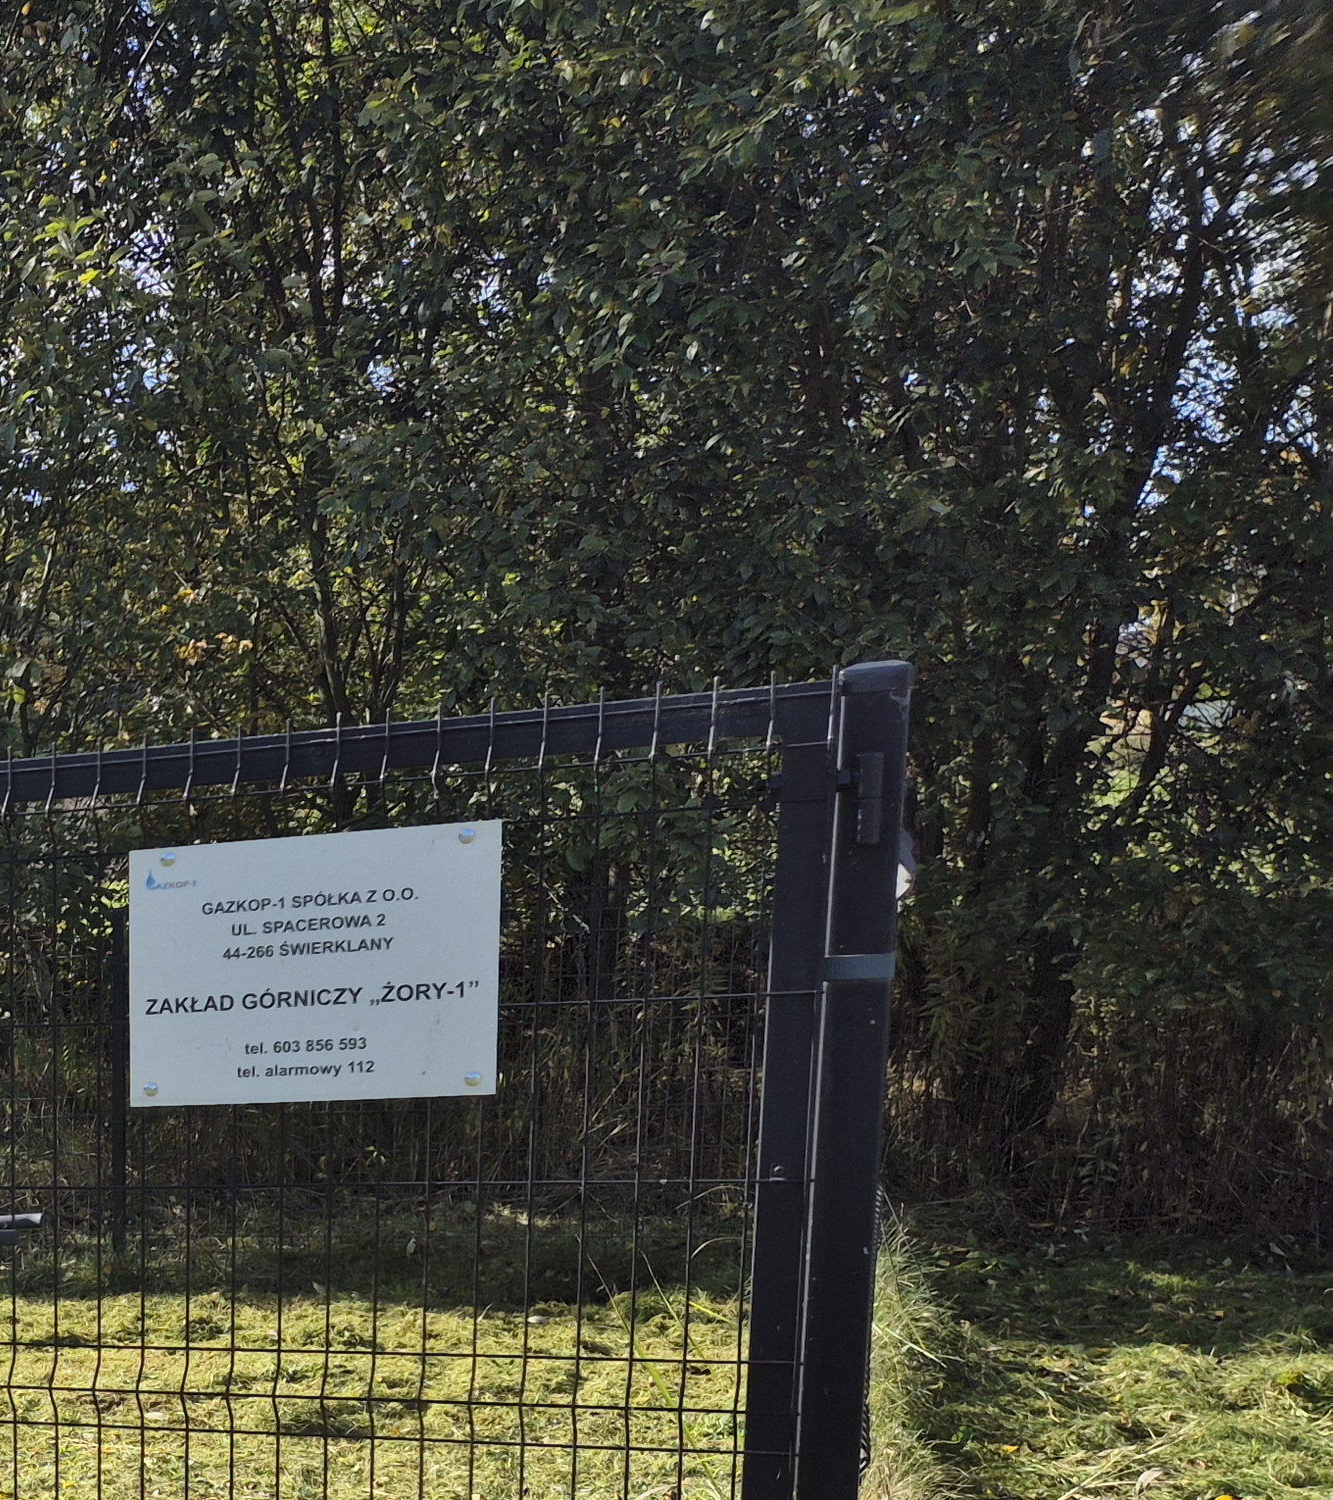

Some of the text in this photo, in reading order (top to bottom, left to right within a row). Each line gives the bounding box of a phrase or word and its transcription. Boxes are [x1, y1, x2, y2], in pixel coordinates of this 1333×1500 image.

[201, 887, 419, 915] GAZKOP-1 SPÓŁKA Z O.O.
[232, 913, 386, 936] UL. SPACEROWA 2
[222, 937, 394, 960] 44-266 ŚWIERKLANY
[145, 994, 234, 1015] ZAKŁAD
[242, 987, 363, 1011] GÓRNICZY
[245, 1037, 367, 1055] tel. 603 856 593
[237, 1061, 375, 1078] tel. alarmowy 112
